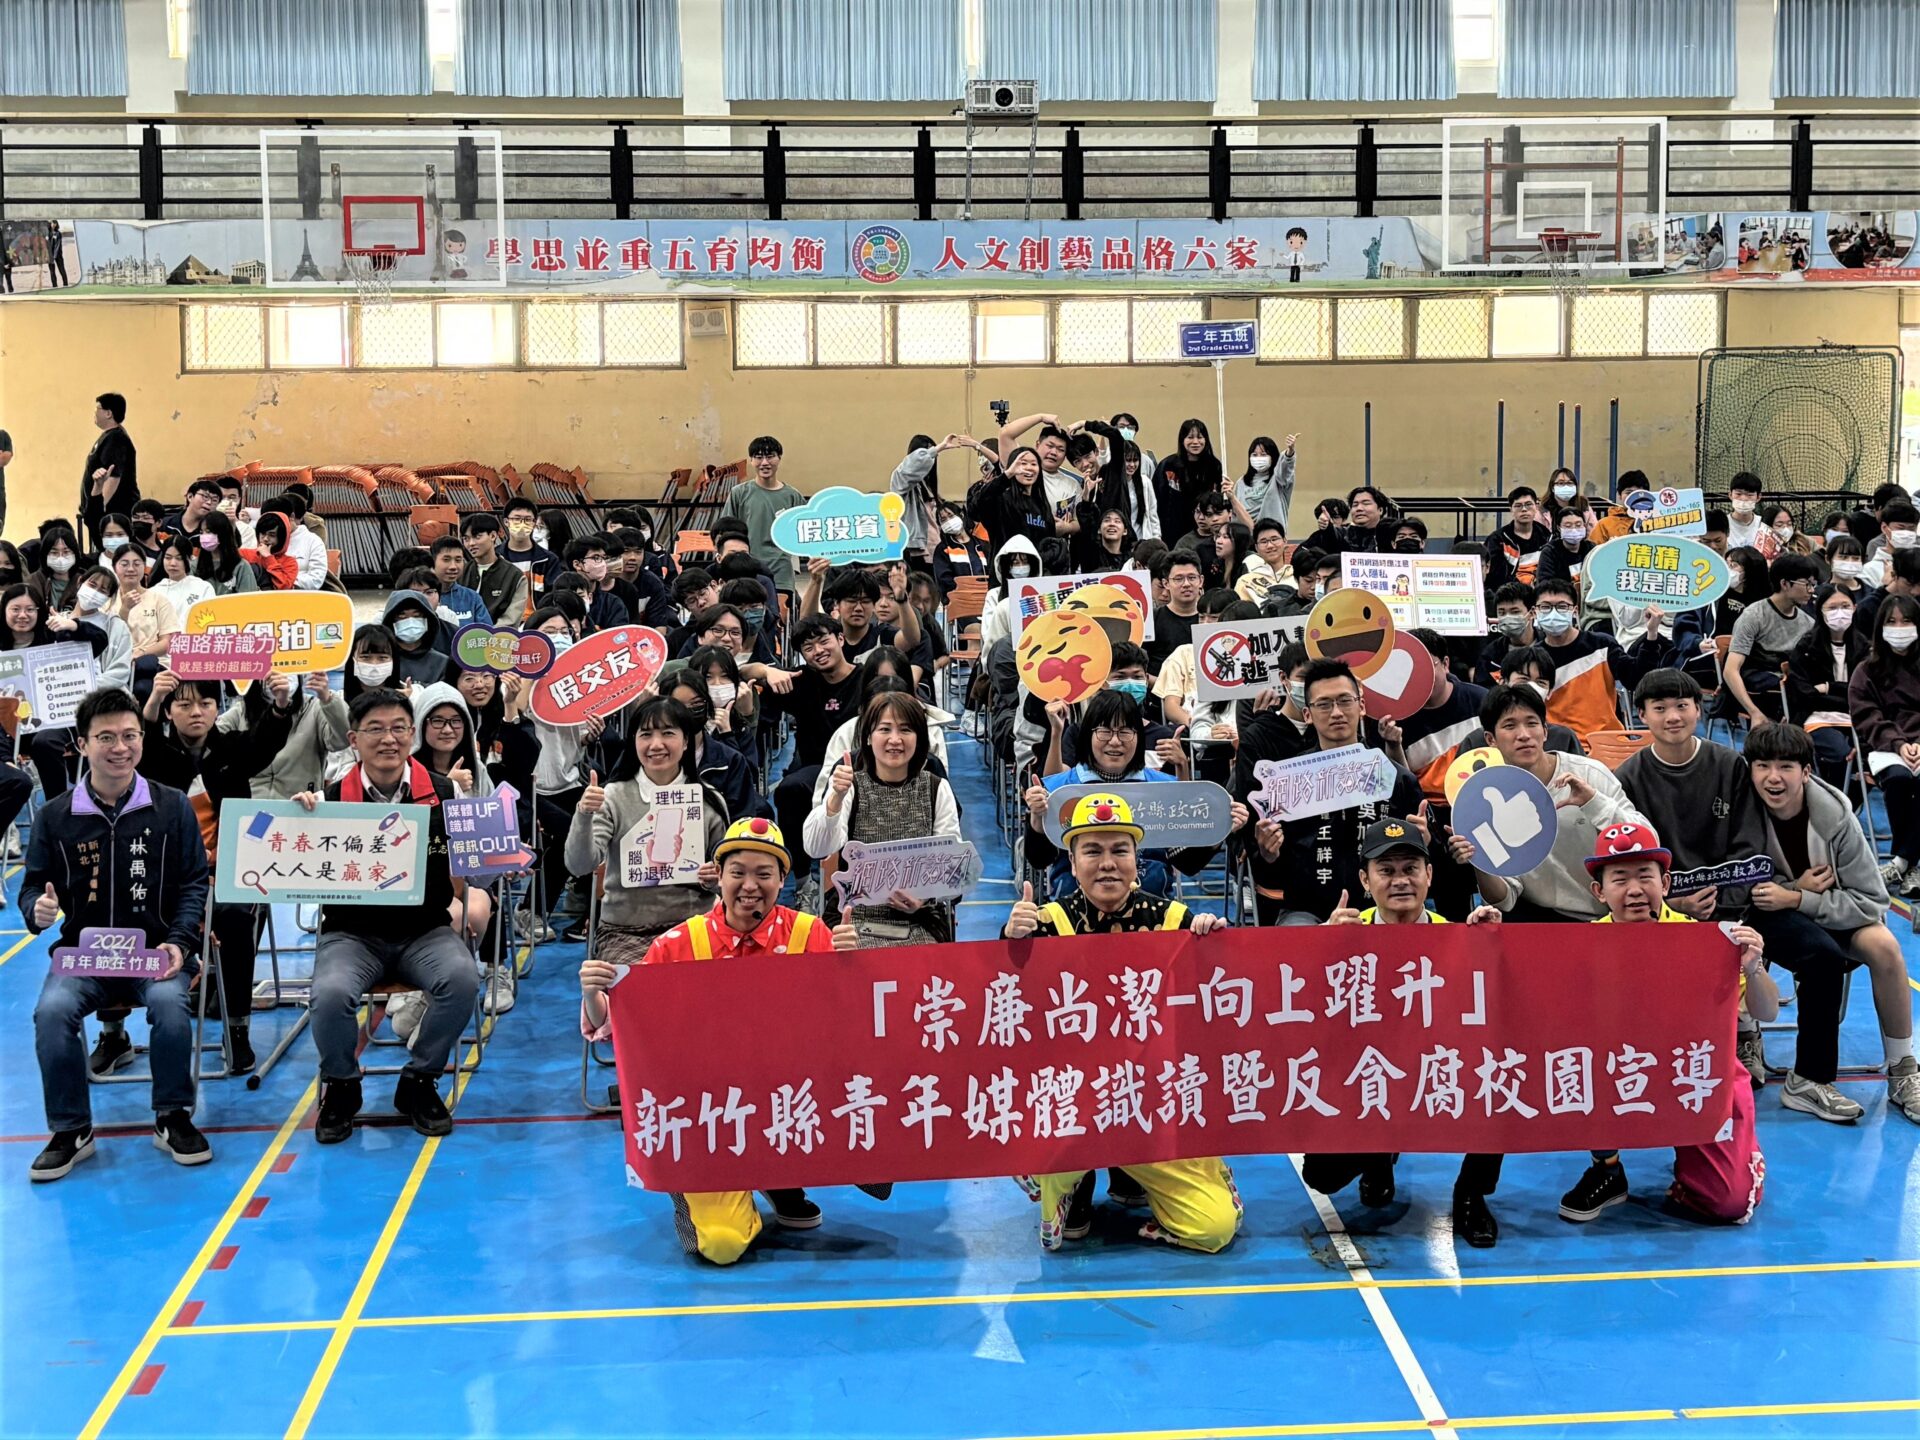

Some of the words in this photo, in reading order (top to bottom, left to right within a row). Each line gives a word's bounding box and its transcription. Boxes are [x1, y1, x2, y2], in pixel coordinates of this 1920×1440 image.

[486, 236, 826, 273] 學思並重五育均衡
[933, 235, 1260, 272] 人文創藝品格六家
[1187, 328, 1249, 343] 二年五班
[796, 514, 881, 543] 假投資
[1626, 542, 1681, 571] 猜猜
[1616, 569, 1690, 597] 我是誰
[168, 633, 276, 655] 網路新識力
[178, 660, 264, 673] 就是我的超能力
[548, 646, 640, 710] 假交友
[1267, 755, 1382, 813] 網路新識力
[655, 788, 701, 806] 理性上
[475, 802, 500, 818] UP
[686, 805, 701, 821] 網
[449, 819, 476, 833] 識讀
[1167, 821, 1214, 830] Government
[267, 832, 388, 854] 青春不偏差
[452, 839, 479, 854] 假訊
[480, 835, 519, 853] OUT
[468, 854, 480, 868] 息
[628, 850, 643, 866] 腦
[1316, 825, 1333, 885] 王祥宇
[129, 836, 148, 901] 林禹佑
[262, 860, 388, 883] 人人是贏家
[628, 864, 675, 883] 粉退散
[850, 849, 973, 895] 網路新識力
[90, 934, 138, 954] 2024
[61, 955, 161, 972] 青年節在竹縣
[633, 1039, 1723, 1163] 新竹縣青年媒體識讀暨反貪腐校園宣導
